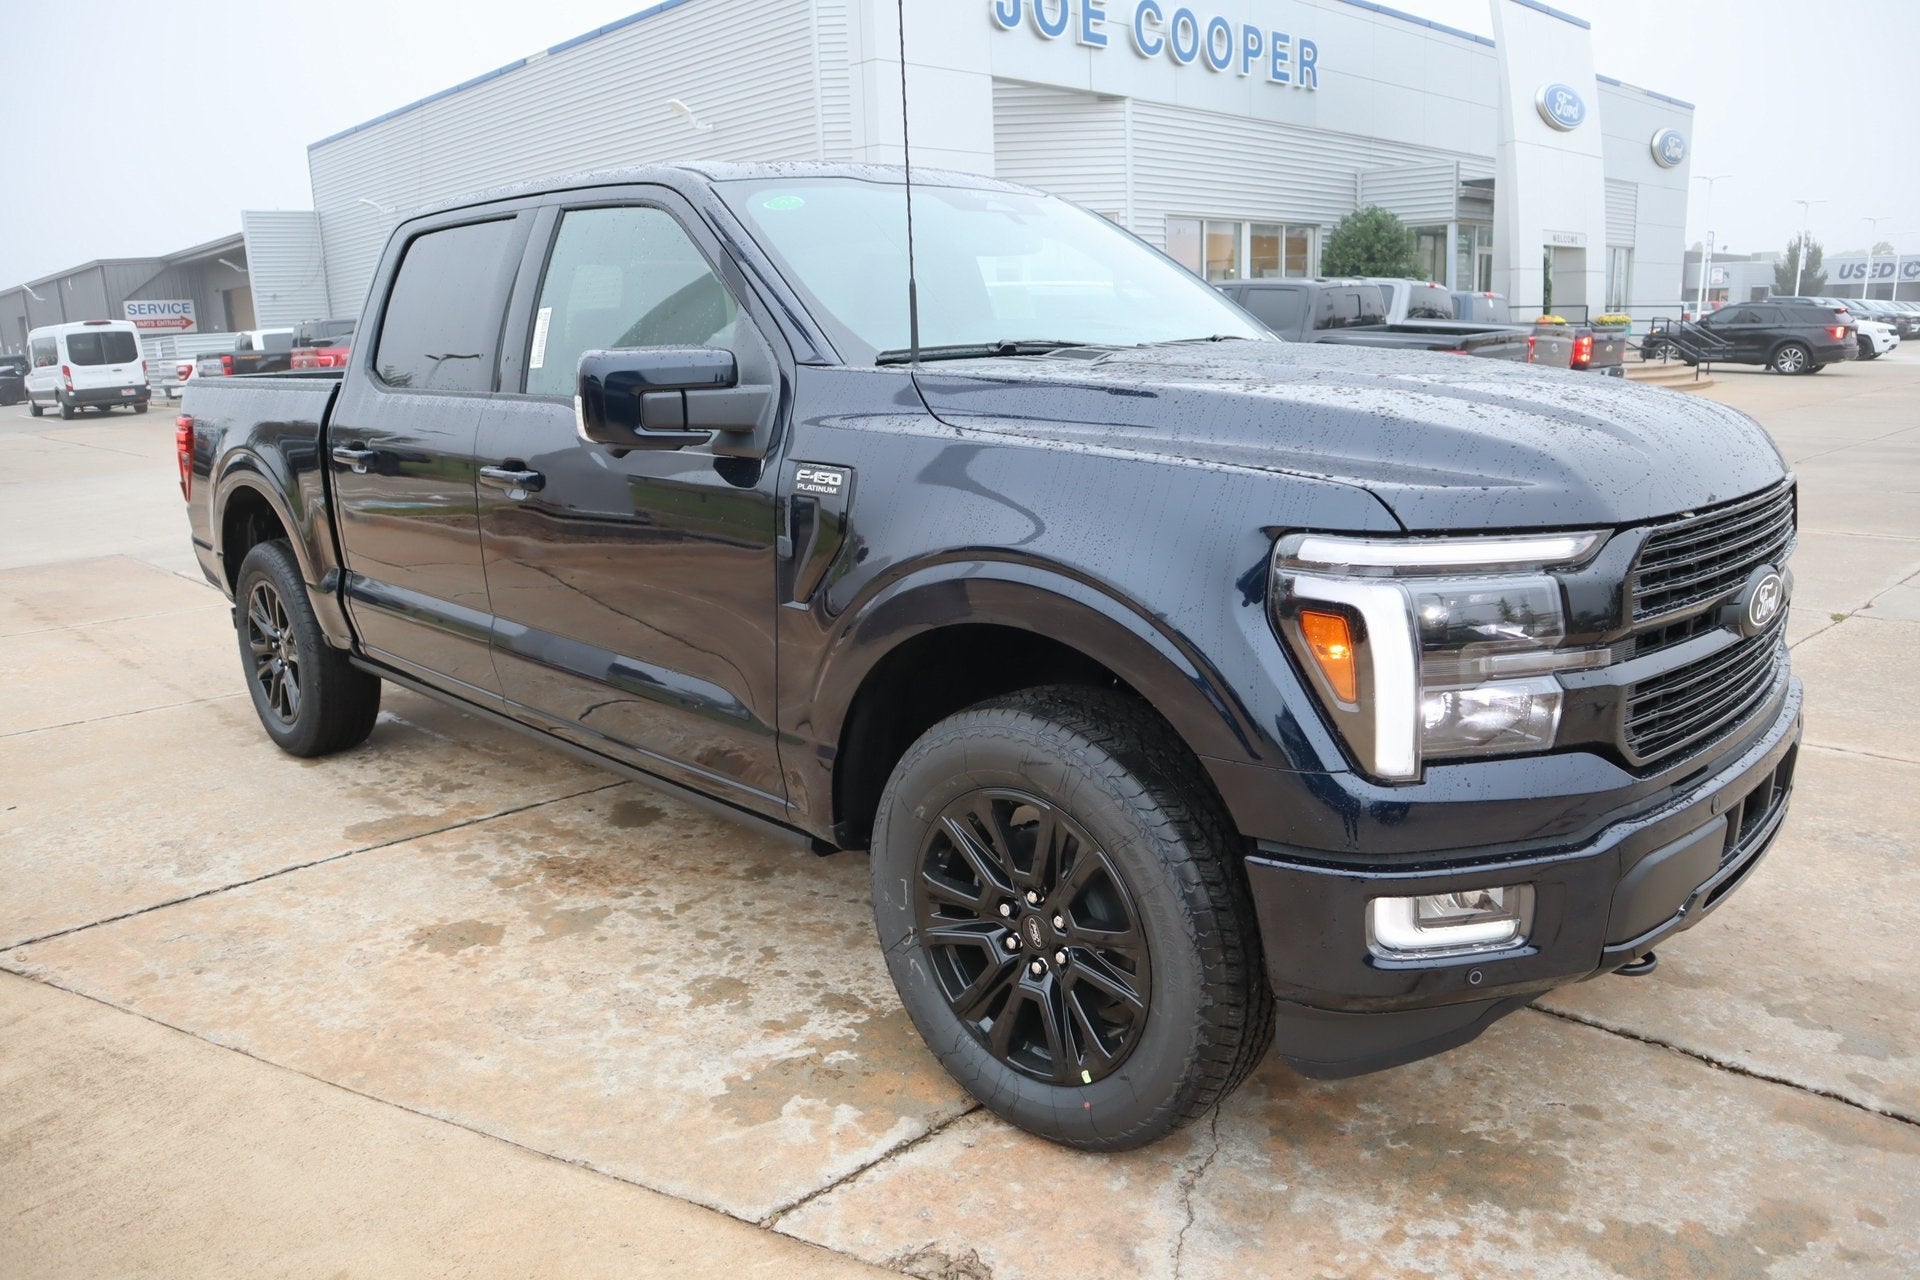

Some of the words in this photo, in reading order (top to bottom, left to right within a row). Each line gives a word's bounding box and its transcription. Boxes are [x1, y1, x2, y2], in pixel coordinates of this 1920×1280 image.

[1131, 0, 1318, 90] COOPER
[1839, 262, 1896, 279] USED
[127, 303, 191, 315] SERVICE
[796, 469, 842, 486] F-150
[797, 483, 837, 494] PLATINUM
